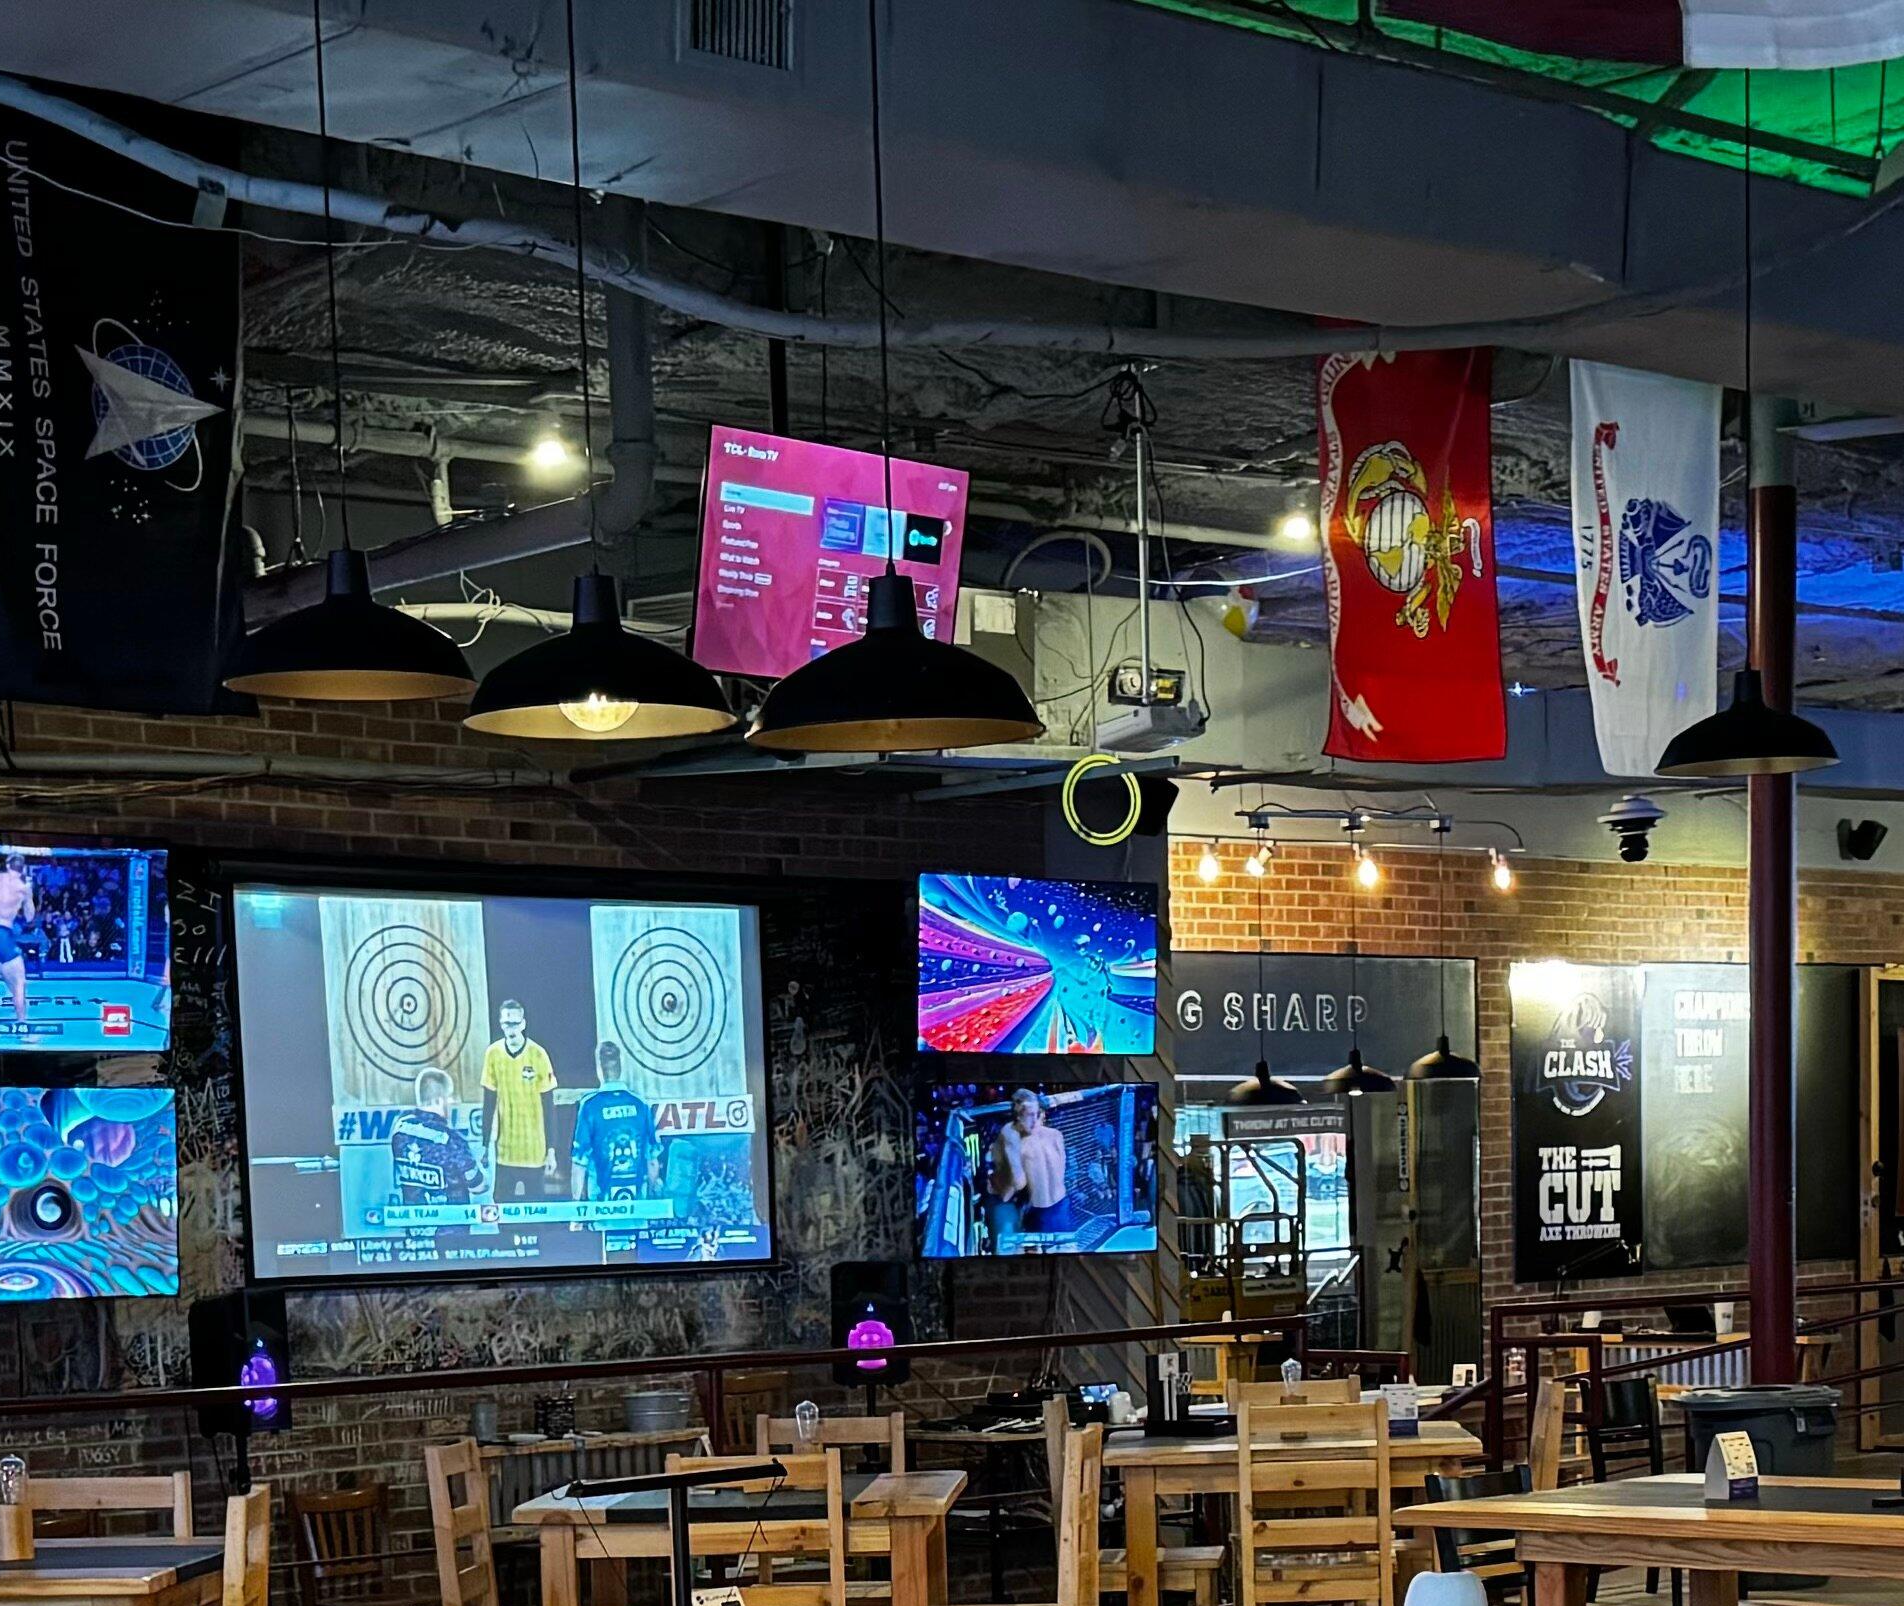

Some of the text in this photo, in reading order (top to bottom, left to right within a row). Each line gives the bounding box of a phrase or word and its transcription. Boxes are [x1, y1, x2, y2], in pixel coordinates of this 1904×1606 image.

[5, 139, 63, 652] UNITED STATES SPACE FORCE
[1322, 352, 1353, 408] NITED
[1580, 524, 1594, 570] 1775
[1590, 602, 1605, 657] ARMY
[1176, 989, 1369, 1032] G SHARP
[1543, 1049, 1615, 1080] CLASH
[650, 1101, 727, 1131] ATL
[1538, 1146, 1577, 1171] THE
[464, 1209, 477, 1220] 14
[576, 1205, 588, 1217] 17
[1539, 1169, 1622, 1224] CUT
[1539, 1223, 1622, 1242] AXE THROWING
